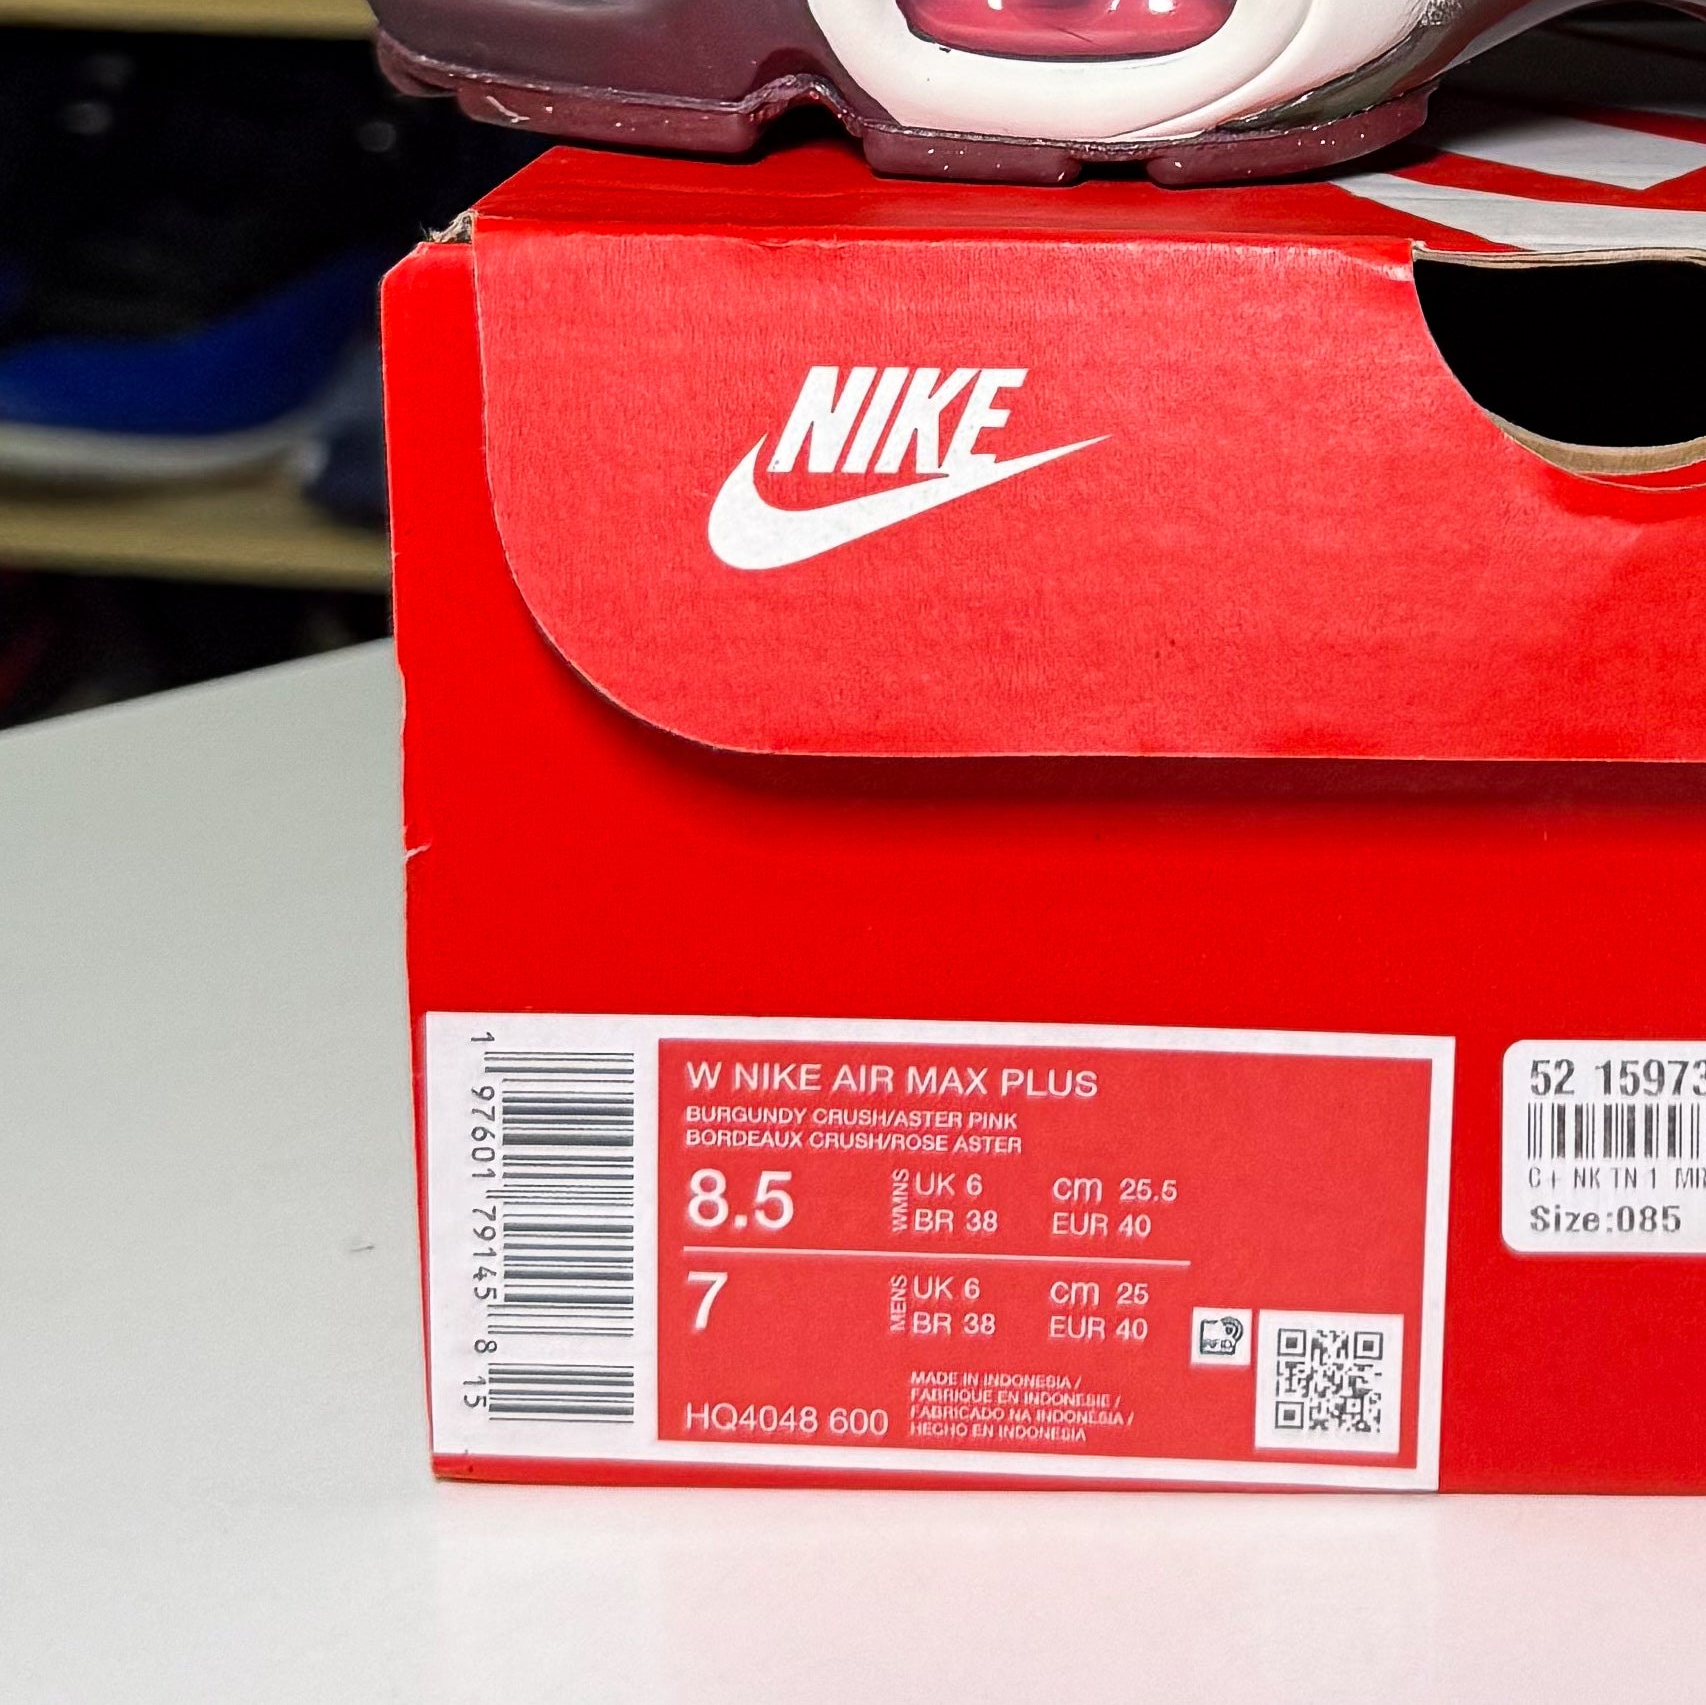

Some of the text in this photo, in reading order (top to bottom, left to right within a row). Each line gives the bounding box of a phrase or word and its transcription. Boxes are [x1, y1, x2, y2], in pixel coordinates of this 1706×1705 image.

[766, 365, 1029, 476] NIKE
[686, 1061, 1099, 1098] W NIKE AIR MAX PLUS
[1530, 1060, 1575, 1096] 52
[686, 1105, 1018, 1130] BURGUNDY CRUSH/ASTER PINK
[470, 1085, 497, 1178] 97601
[686, 1128, 1022, 1154] BORDEAUX CRUSH/ROSE ASTER
[914, 1172, 983, 1197] UK 6
[1052, 1177, 1178, 1203] cm 25.5
[687, 1167, 795, 1230] 8.5
[891, 1167, 910, 1234] WMNS
[914, 1208, 999, 1233] BR 38
[1052, 1212, 1151, 1238] EUR 40
[1530, 1204, 1682, 1233] Size:085
[471, 1205, 498, 1300] 79145
[687, 1270, 728, 1330] 7
[912, 1275, 981, 1301] UK 6
[1050, 1281, 1150, 1306] cm 25
[889, 1275, 908, 1333] MENS
[912, 1312, 996, 1336] BR 38
[1050, 1315, 1149, 1342] EUR 40
[474, 1338, 498, 1354] 8
[463, 1375, 487, 1409] 15
[910, 1371, 958, 1387] MADE
[962, 1372, 980, 1387] IN
[910, 1388, 993, 1406] FABRIQUE
[997, 1390, 1020, 1406] EN
[686, 1402, 889, 1436] HQ4048 600
[910, 1405, 1005, 1422] FABRICADO
